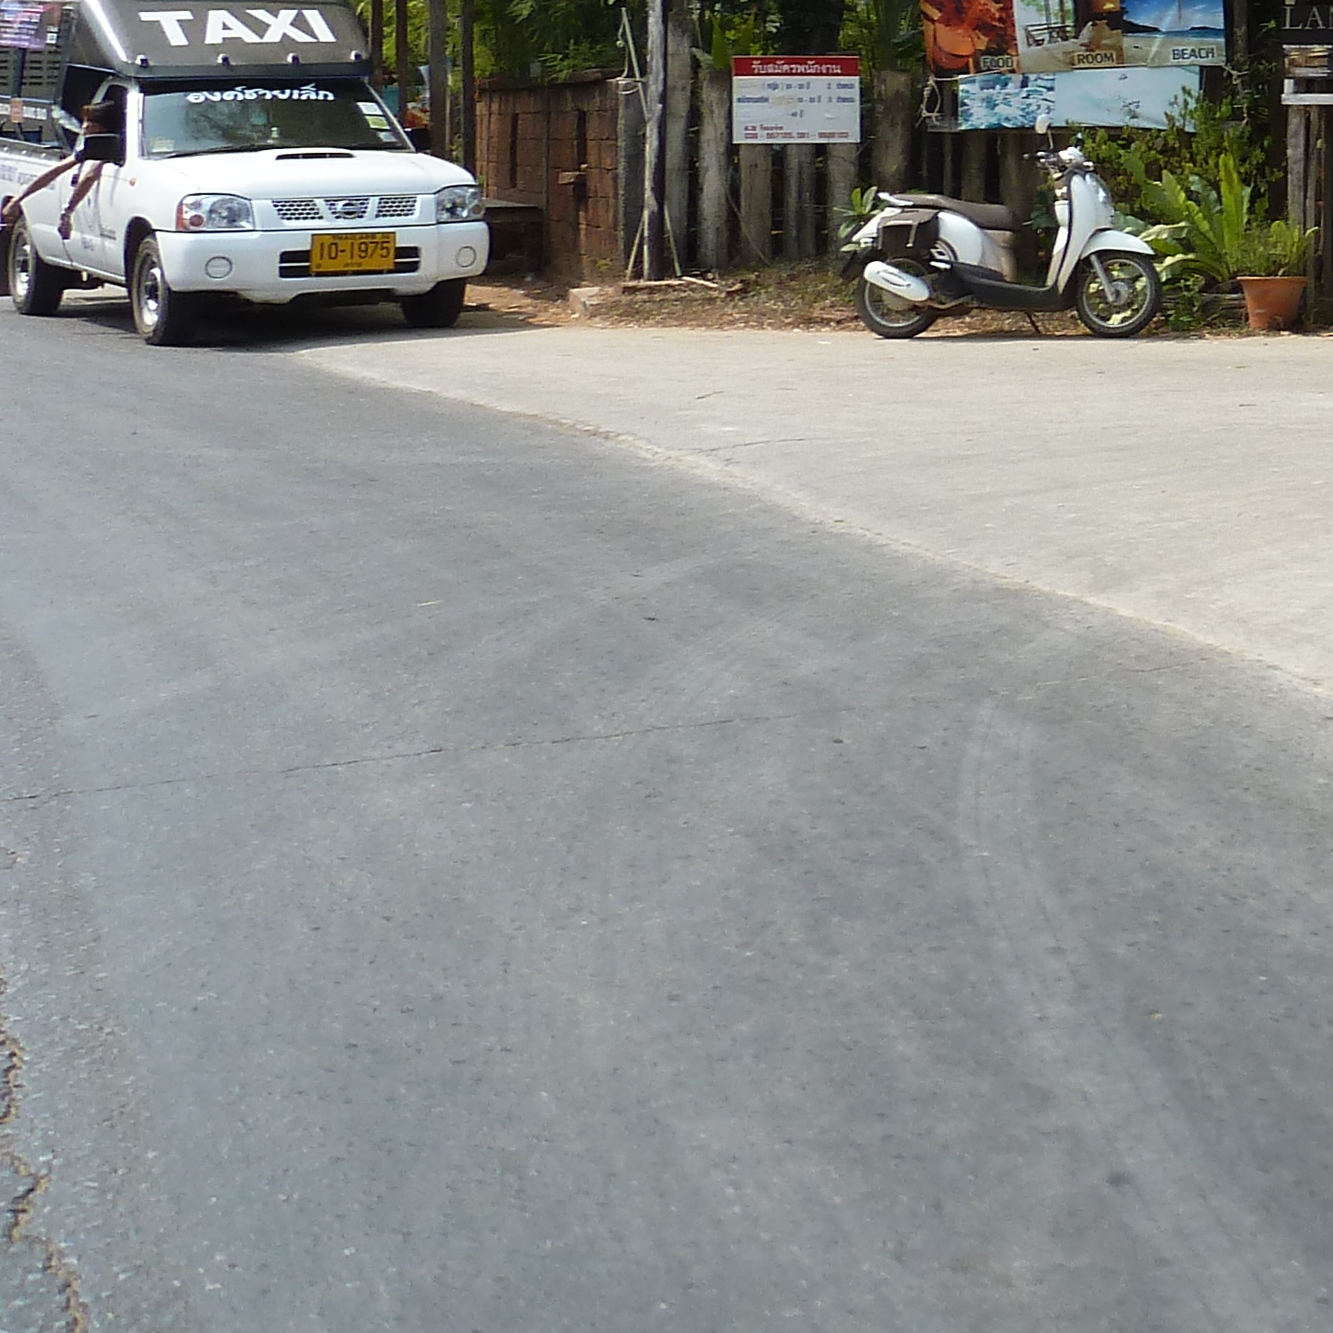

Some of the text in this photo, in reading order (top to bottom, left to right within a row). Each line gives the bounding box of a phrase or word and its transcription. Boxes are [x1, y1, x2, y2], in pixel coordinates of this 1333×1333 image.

[139, 9, 337, 46] TAXI
[1076, 53, 1115, 65] ROOM
[1172, 47, 1215, 60] BEACH
[982, 56, 1014, 68] FOOD
[319, 240, 391, 261] 10-1975
